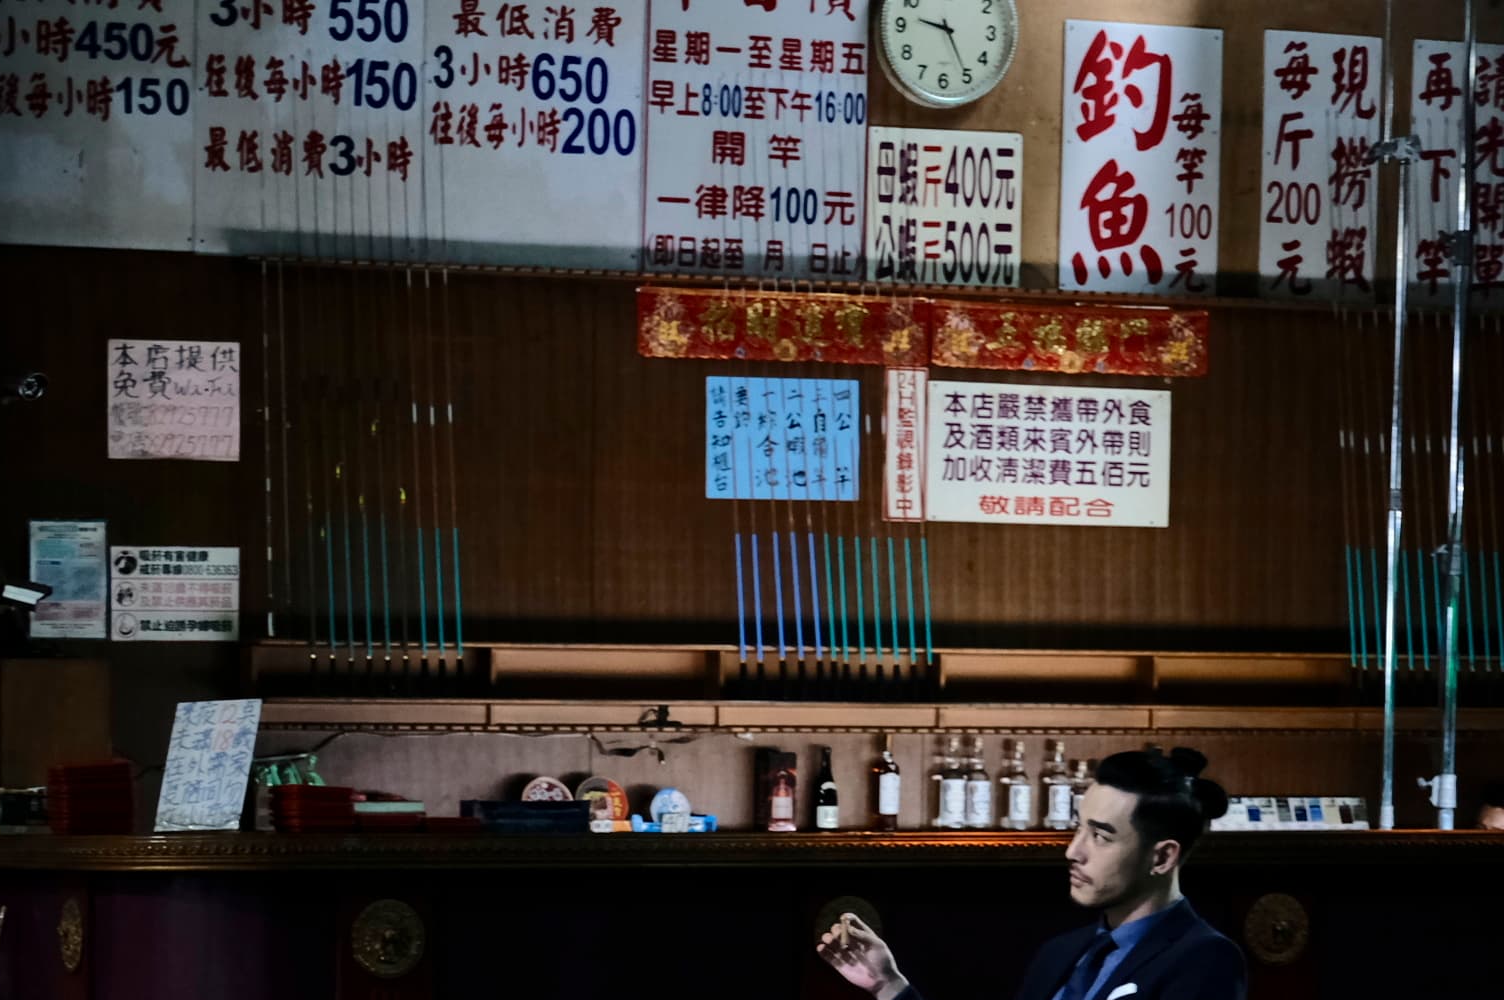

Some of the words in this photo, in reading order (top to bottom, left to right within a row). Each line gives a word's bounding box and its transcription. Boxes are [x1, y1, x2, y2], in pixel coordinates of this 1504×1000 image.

[452, 0, 623, 46] 最低消費
[895, 16, 907, 33] 9
[981, 0, 993, 15] 2
[651, 28, 866, 75] 星期一至星期五
[985, 25, 997, 42] 3
[901, 44, 913, 61] 8
[977, 50, 989, 67] 4
[203, 52, 417, 110] 往後每小時150
[432, 44, 609, 104] 3小時650
[917, 64, 928, 80] 7
[937, 73, 949, 90] 6
[961, 68, 973, 85] 5
[648, 79, 867, 125] 早上8:00至下午16:00
[429, 101, 636, 156] 往後每小時200
[202, 125, 414, 182] 最低消費3小時
[711, 130, 802, 169] 開竿
[1070, 27, 1176, 288] 釣魚
[1265, 40, 1322, 296] 每斤200元
[656, 184, 856, 227] 一律降100元
[112, 343, 238, 372] 本店提供
[943, 390, 1154, 427] 本店嚴禁攜帶外食
[941, 421, 1153, 459] 及酒類來賓外帶則
[940, 454, 1152, 489] 加收清潔費五佰元
[977, 493, 1116, 519] 敬請配合
